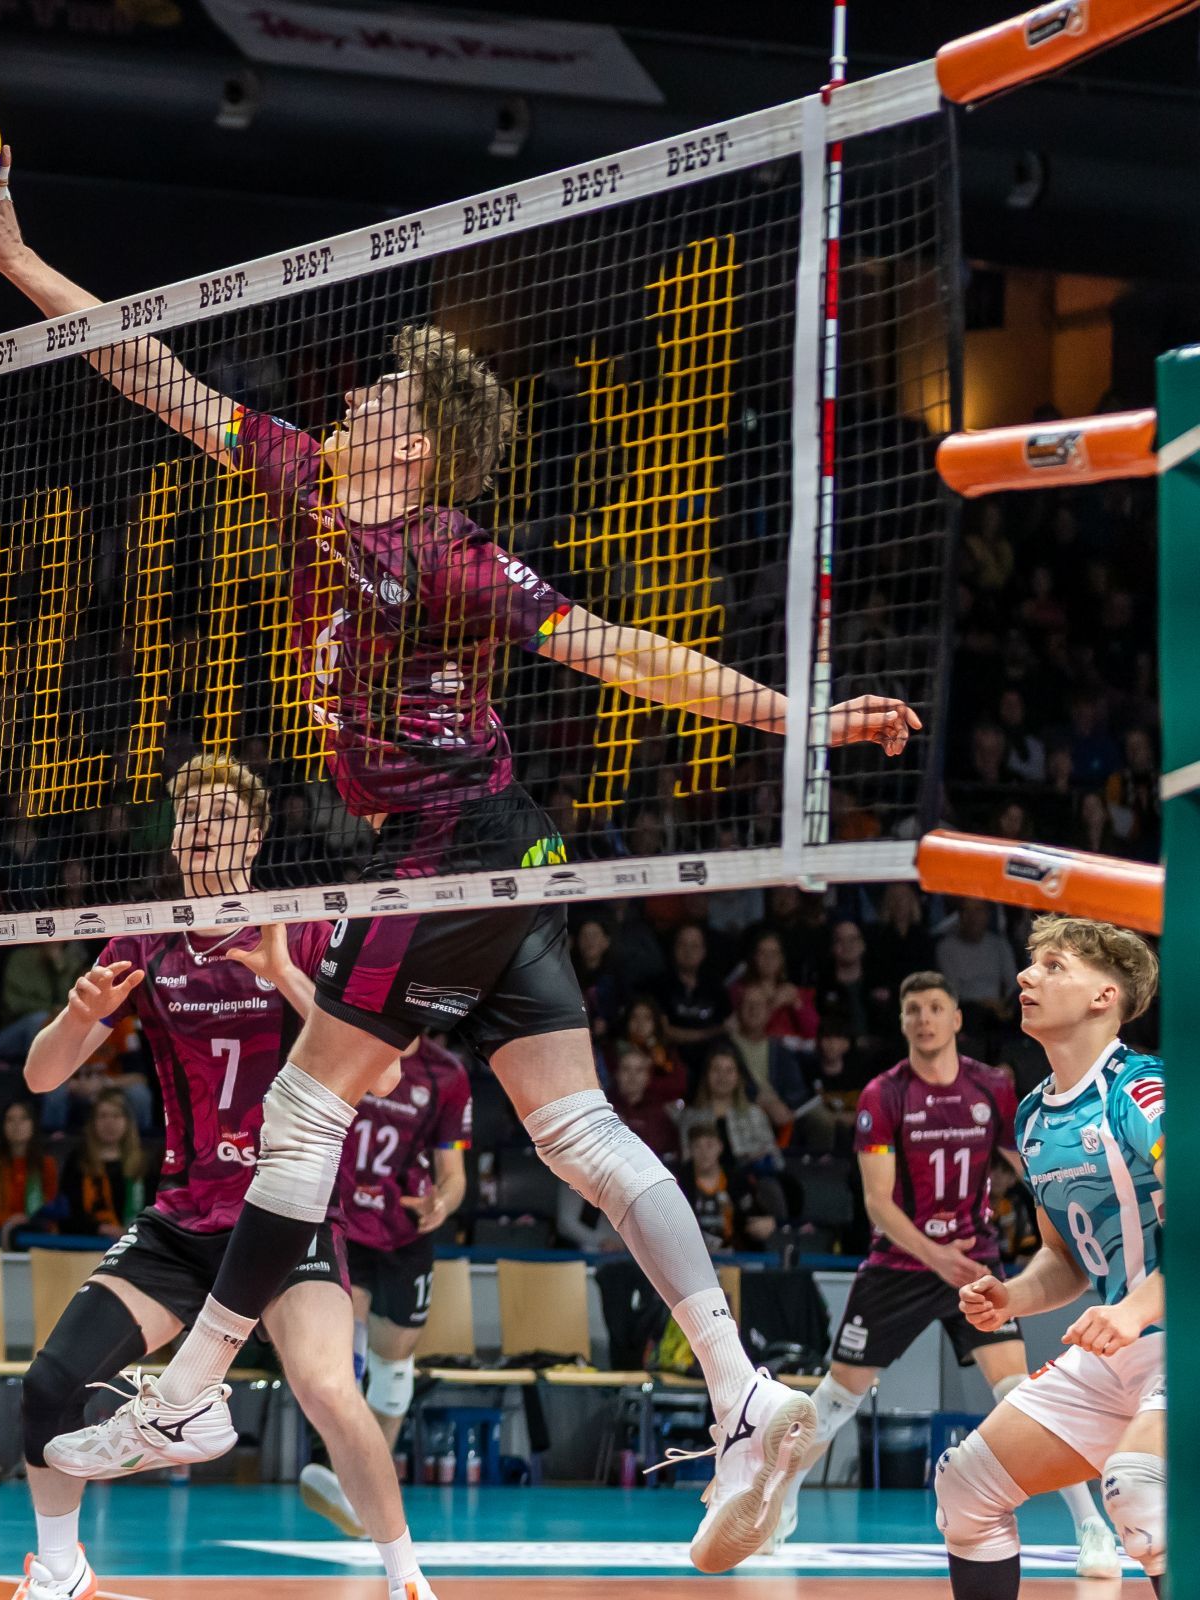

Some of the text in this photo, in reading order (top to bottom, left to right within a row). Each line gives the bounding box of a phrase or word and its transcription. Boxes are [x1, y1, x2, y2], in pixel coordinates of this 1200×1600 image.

[126, 915, 142, 925] BERLIN
[156, 975, 188, 987] capelli
[183, 997, 268, 1013] energiequelle
[439, 996, 469, 1010] Landkreis
[211, 1038, 240, 1110] 7
[355, 1120, 399, 1177] 12
[929, 1148, 971, 1201] 11
[1068, 1201, 1110, 1276] 8
[295, 1260, 331, 1272] apelli
